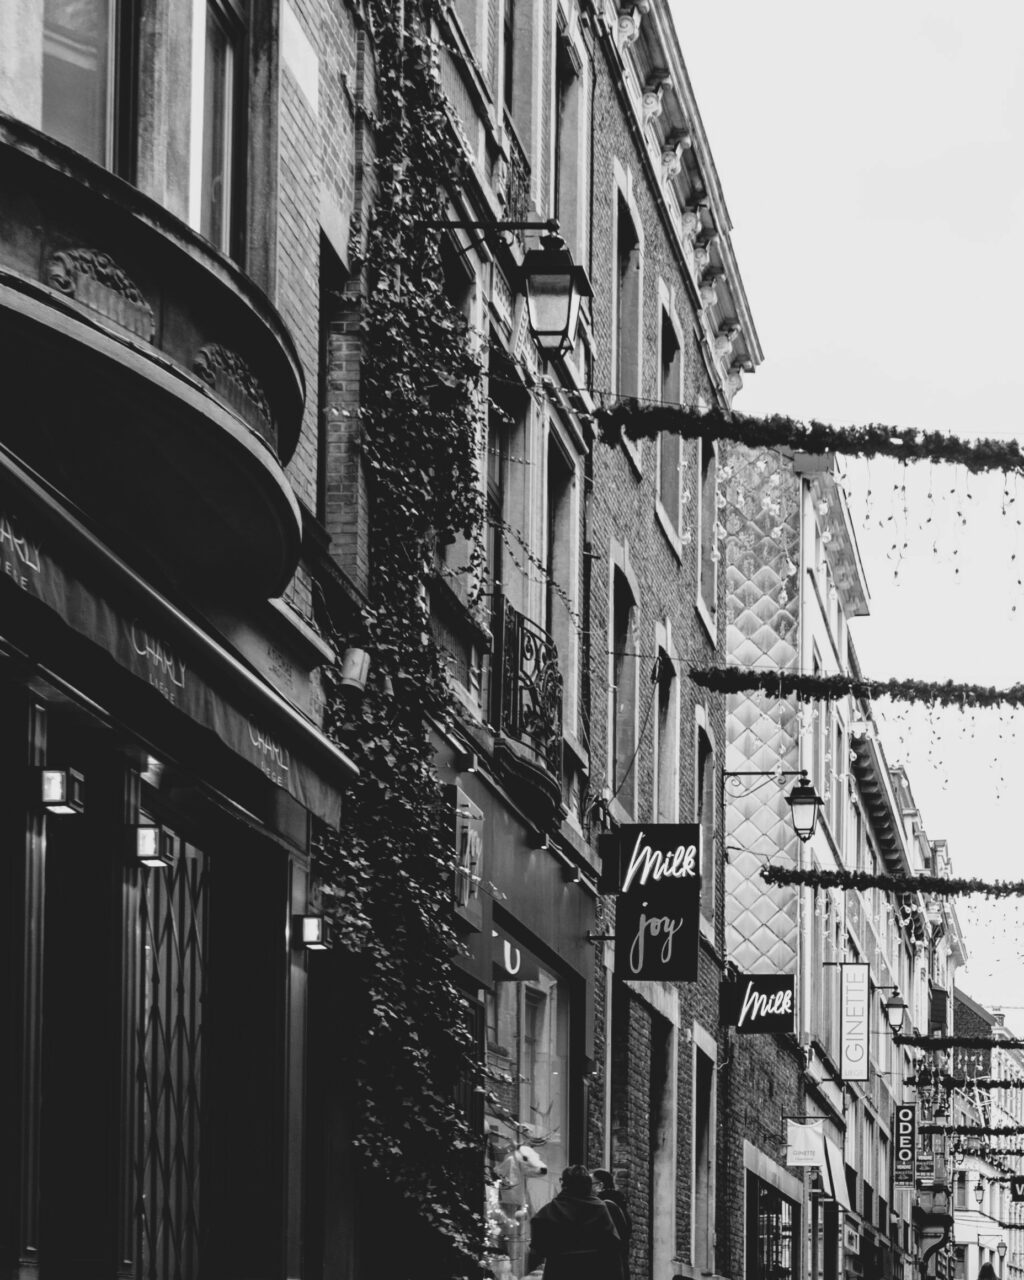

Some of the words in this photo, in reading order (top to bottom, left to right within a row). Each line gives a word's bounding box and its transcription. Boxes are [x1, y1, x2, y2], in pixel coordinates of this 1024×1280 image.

[630, 902, 683, 974] joy
[845, 972, 865, 1063] GINETTE
[898, 1108, 913, 1161] ODEO
